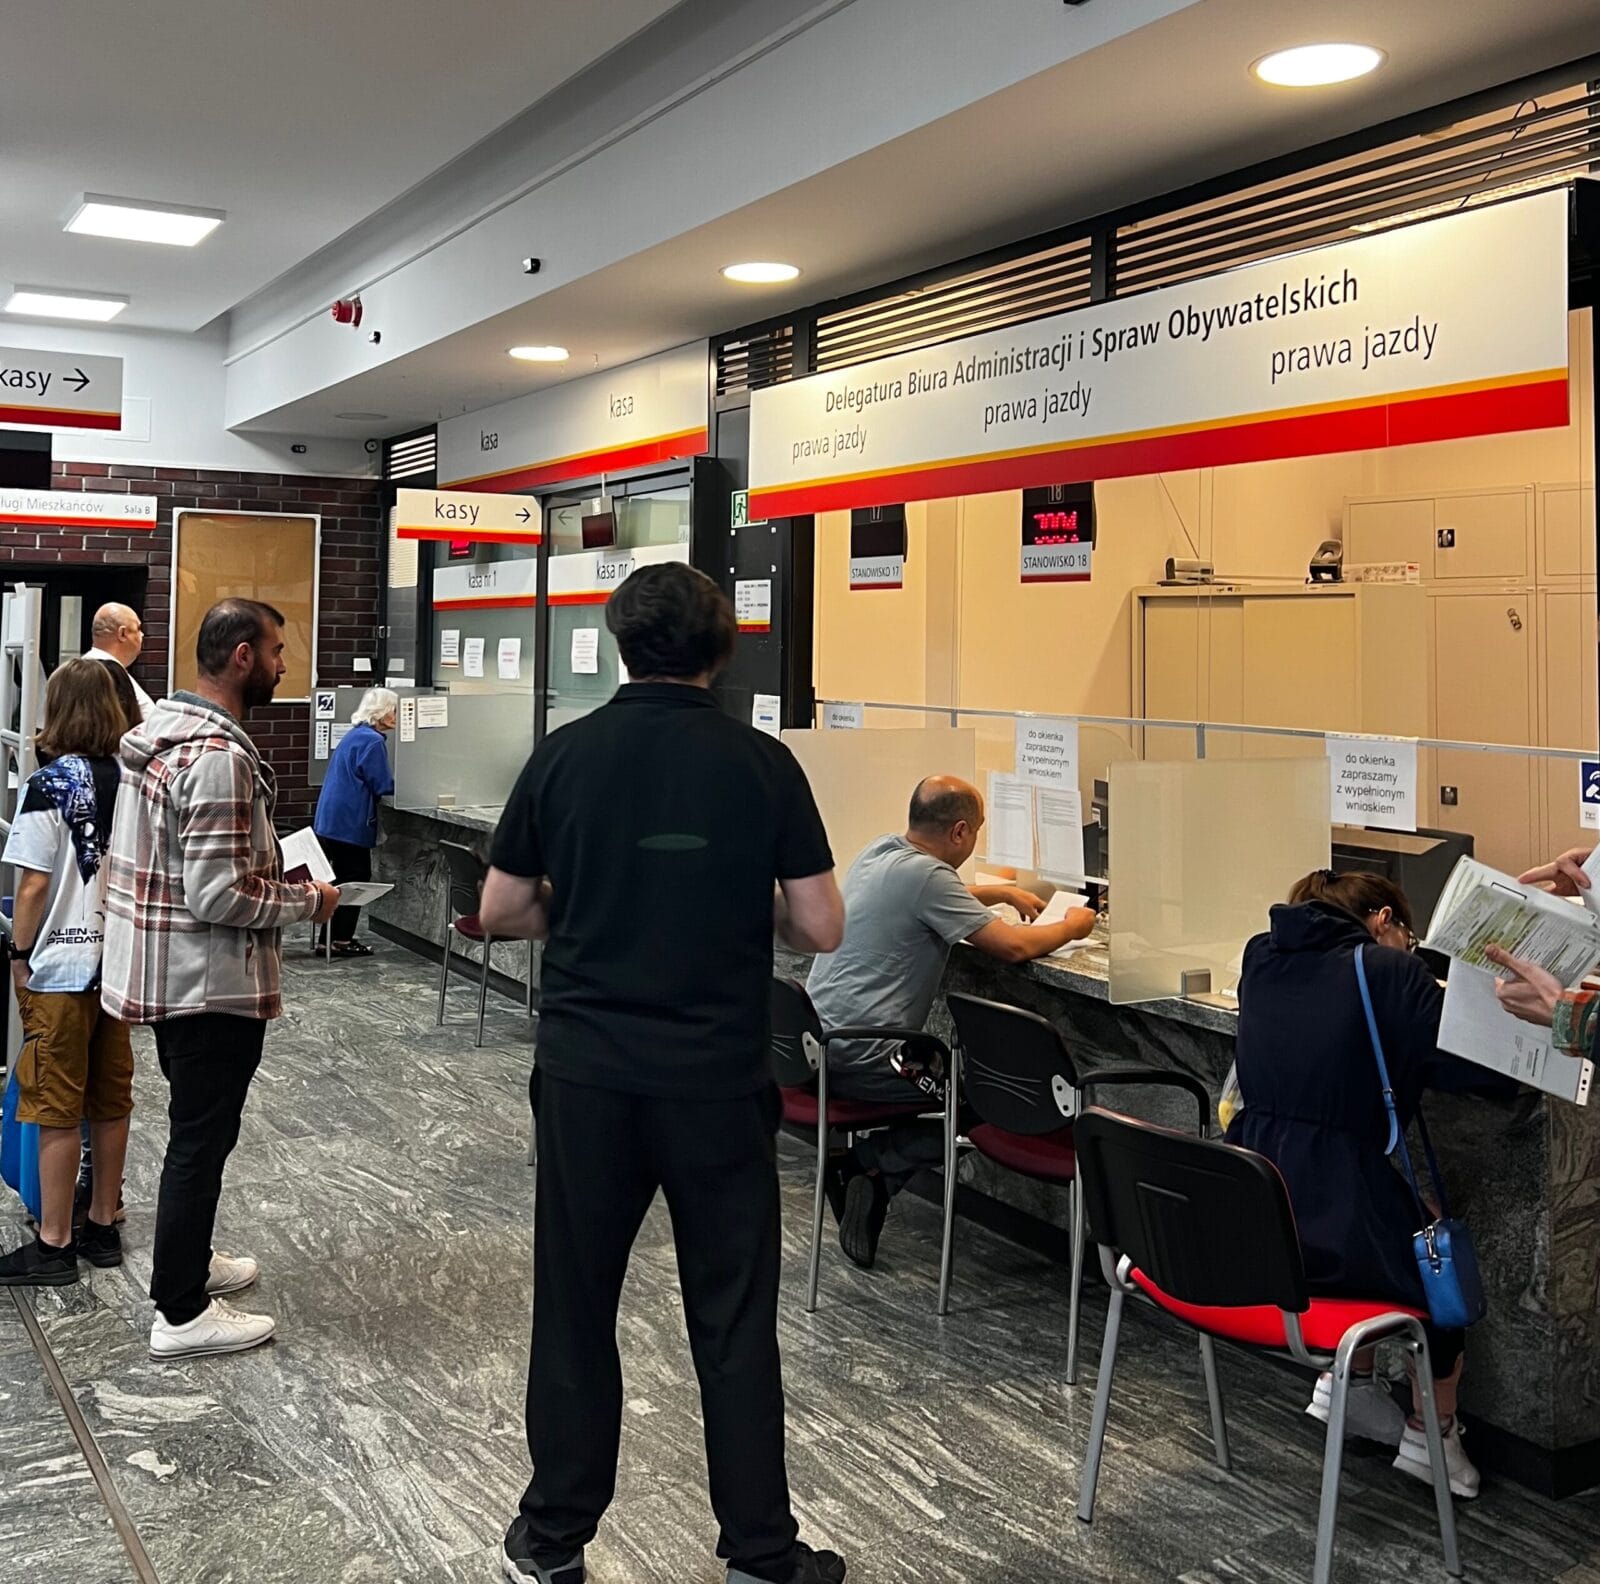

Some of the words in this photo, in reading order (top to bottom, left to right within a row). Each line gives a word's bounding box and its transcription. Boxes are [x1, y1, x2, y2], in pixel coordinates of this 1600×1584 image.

[826, 378, 902, 413] Delegatura
[908, 368, 948, 397] Biura
[953, 334, 1072, 386] Administracji
[1079, 330, 1086, 360] i
[1092, 318, 1161, 362] Spraw
[1168, 269, 1358, 342] Obywatelskich
[1271, 337, 1352, 385] prawa
[1361, 314, 1438, 370] jazdy
[609, 392, 634, 420] kasa
[984, 396, 1037, 433] prawa
[1042, 380, 1092, 424] jazdy
[480, 429, 499, 452] kasa
[792, 434, 829, 465] prawa
[832, 423, 867, 459] jazdy
[26, 496, 104, 514] Mieszkańców
[124, 504, 142, 515] Sala
[434, 496, 480, 526] kasy
[1023, 554, 1075, 569] STANOWISKO
[1078, 553, 1087, 567] 18
[597, 559, 616, 581] kasa
[618, 561, 628, 579] nr
[851, 566, 891, 579] STANOWISKO
[892, 565, 900, 577] 17
[468, 571, 483, 589] kasa
[1028, 729, 1037, 740] do
[1038, 730, 1064, 742] okienka
[1025, 742, 1065, 757] zapraszamy
[1021, 754, 1027, 763] z
[1345, 753, 1357, 764] do
[1359, 754, 1395, 766] okienka
[1028, 768, 1063, 780] wnioskiem
[1341, 770, 1398, 785] zapraszamy
[1336, 785, 1342, 794] z
[1344, 785, 1405, 802] wypełnionym
[1346, 802, 1395, 814] wnioskiem
[48, 927, 87, 938] ALIEN
